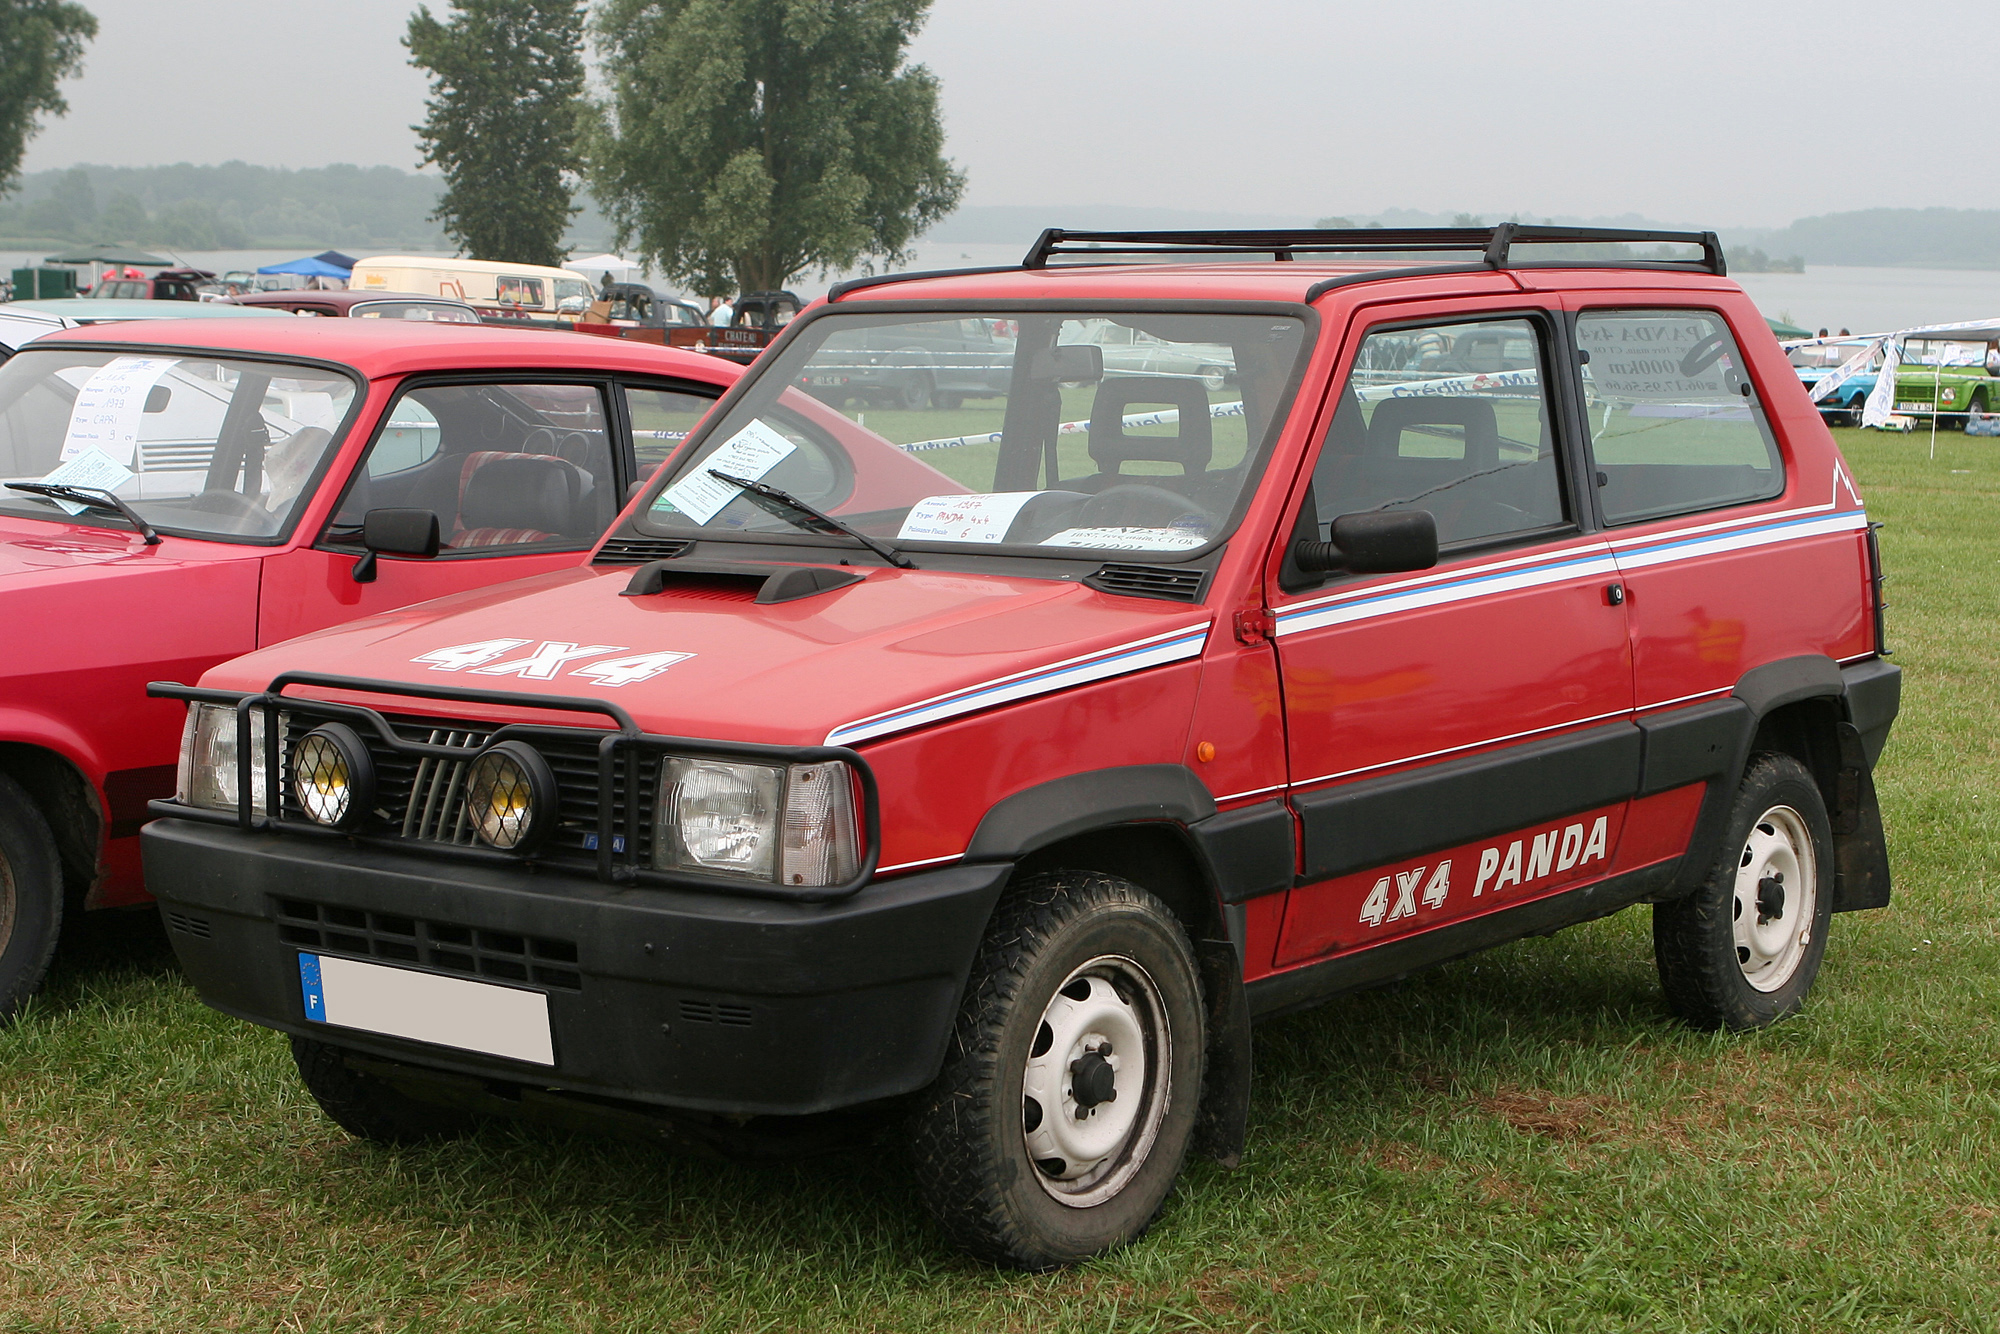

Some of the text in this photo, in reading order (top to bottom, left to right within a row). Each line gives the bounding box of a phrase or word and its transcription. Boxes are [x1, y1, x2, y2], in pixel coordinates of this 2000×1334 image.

[109, 385, 131, 395] FORD
[1392, 380, 1468, 398] Crédit
[101, 398, 125, 409] 1979
[960, 528, 971, 538] 6
[409, 637, 699, 688] 4X4
[1359, 815, 1608, 928] 4X4 PANDA
[309, 994, 318, 1010] F
